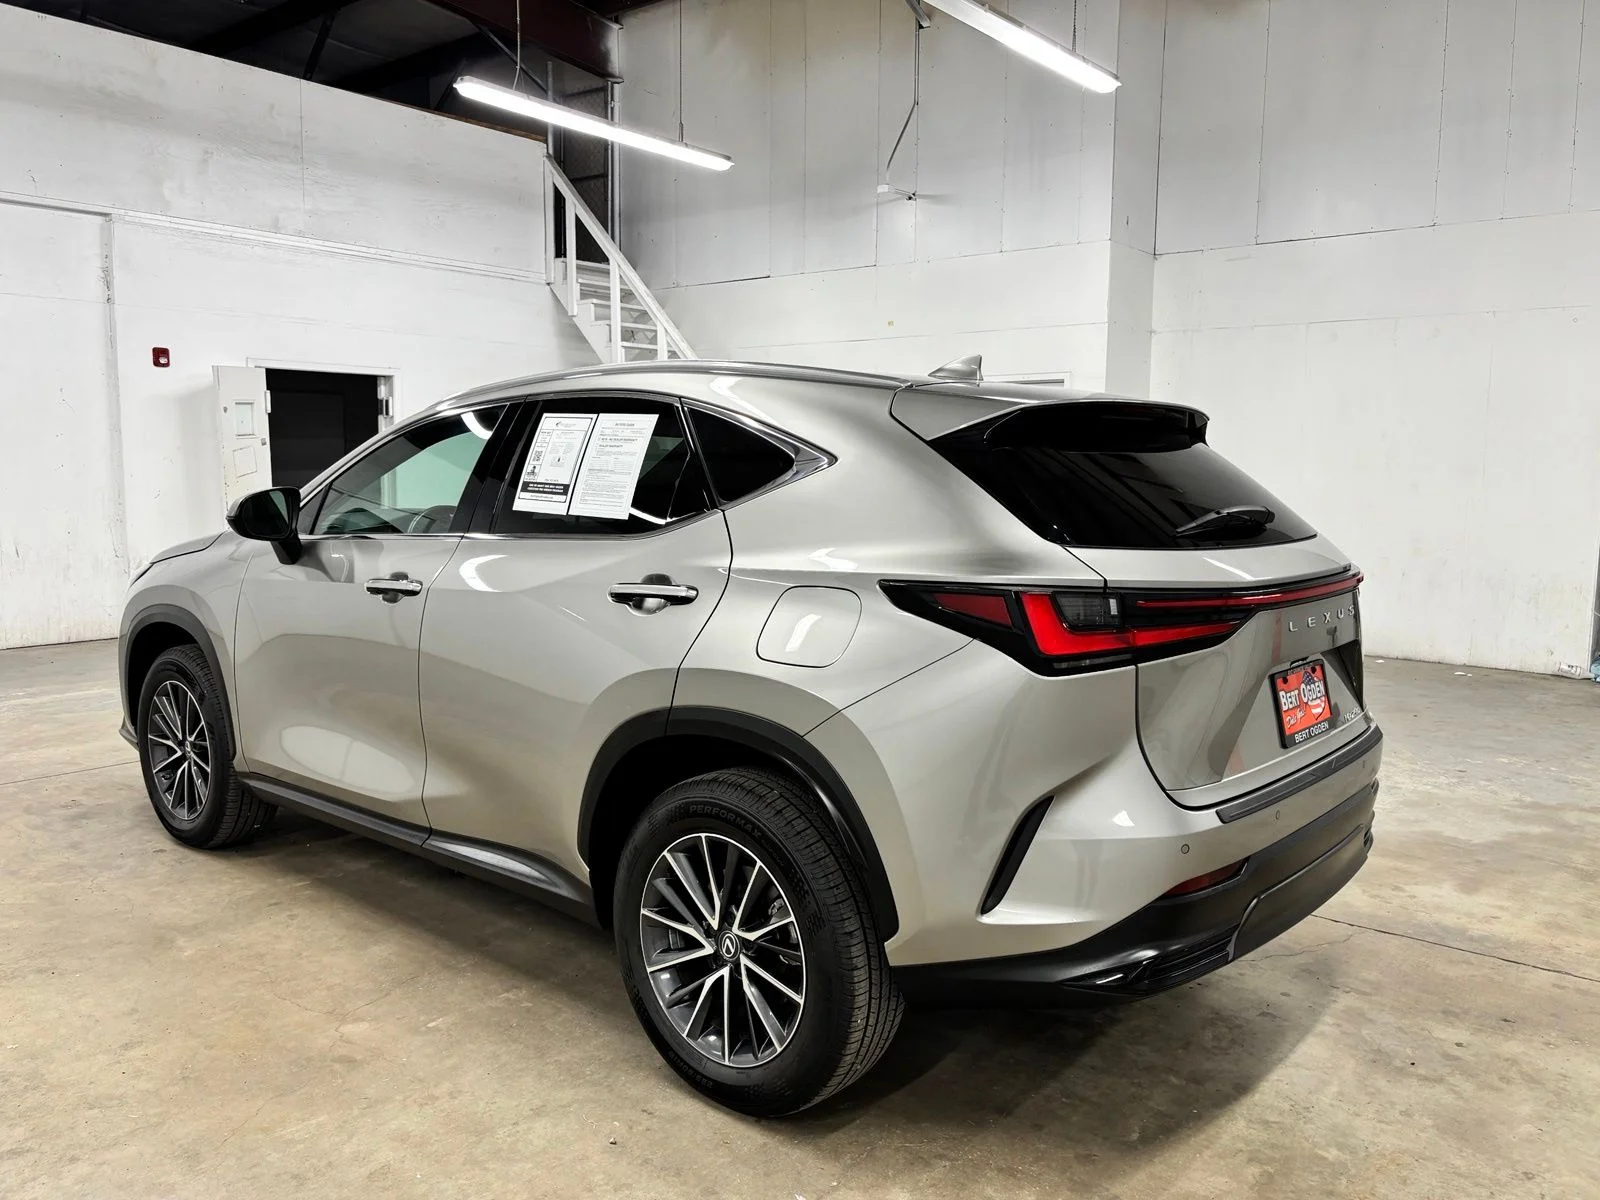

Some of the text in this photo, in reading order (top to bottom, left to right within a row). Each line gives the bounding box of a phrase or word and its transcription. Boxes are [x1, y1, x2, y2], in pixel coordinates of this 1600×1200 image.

[1288, 605, 1354, 632] LEXUS
[1279, 680, 1325, 711] BERT OGDEN
[1294, 721, 1329, 743] BERT OGDEN
